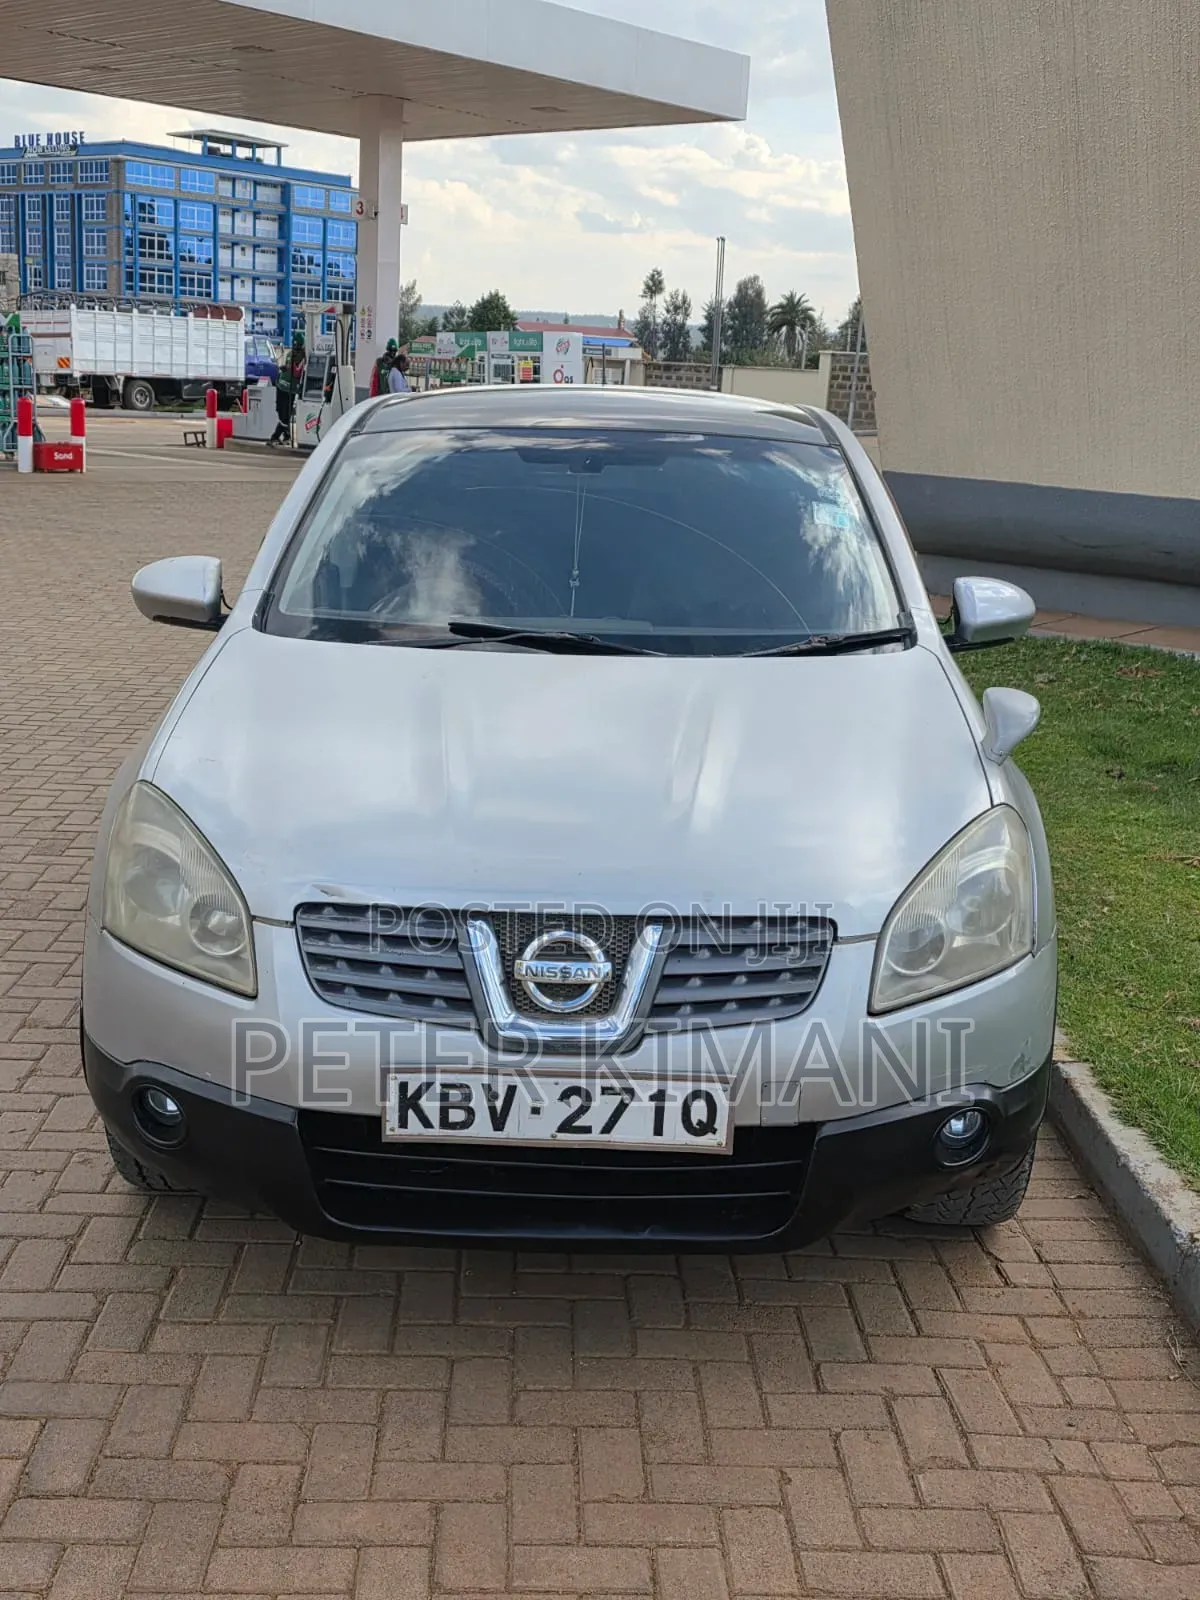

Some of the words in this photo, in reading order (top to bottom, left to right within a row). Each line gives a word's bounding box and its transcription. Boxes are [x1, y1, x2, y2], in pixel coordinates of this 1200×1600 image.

[14, 134, 41, 149] BLUE
[46, 131, 85, 146] HOUSE
[356, 200, 364, 216] 3
[54, 451, 73, 460] Sand
[525, 964, 600, 980] NISSAN
[398, 1081, 518, 1133] KBV
[555, 1085, 718, 1138] 271Q
